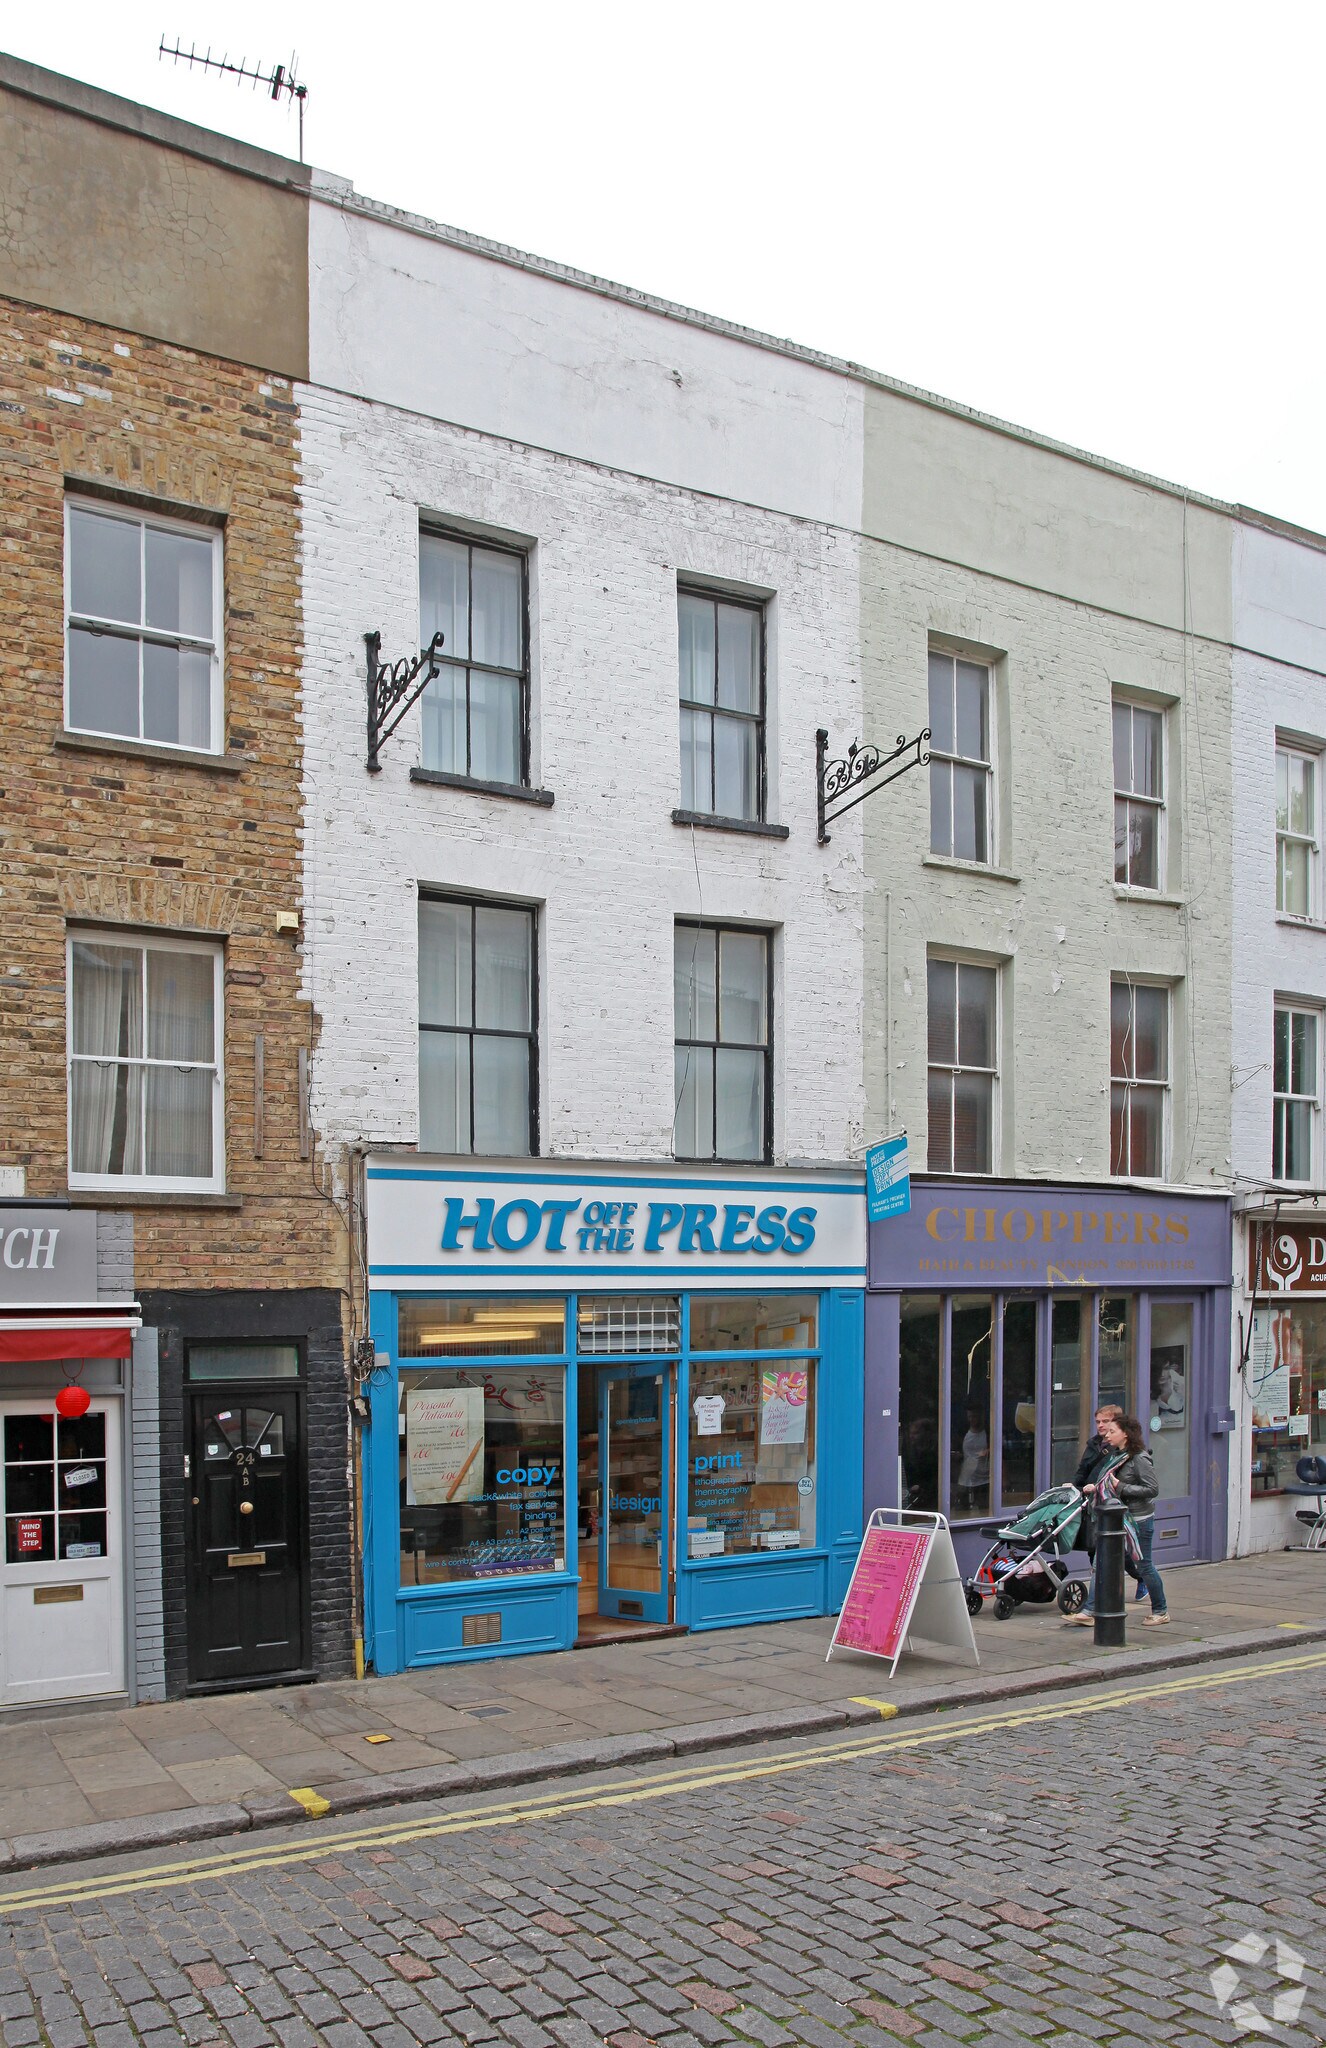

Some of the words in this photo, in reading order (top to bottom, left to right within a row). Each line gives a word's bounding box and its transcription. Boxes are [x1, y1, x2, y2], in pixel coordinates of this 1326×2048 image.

[872, 1158, 894, 1176] DESIGN
[874, 1169, 891, 1186] COPY
[876, 1176, 894, 1194] PRINT
[583, 1201, 638, 1225] OFF
[441, 1197, 583, 1250] HOT
[644, 1202, 818, 1253] PRESS
[925, 1206, 1190, 1244] CHOPPERS
[576, 1227, 635, 1251] THE
[919, 1258, 961, 1271] HAIR
[979, 1258, 1039, 1271] BEAUTY
[1046, 1258, 1110, 1271] LONDON
[412, 1397, 456, 1412] Personal
[615, 1416, 639, 1426] opening
[236, 1452, 255, 1466] 24
[694, 1450, 743, 1474] print
[72, 1473, 90, 1482] CLOSED
[242, 1467, 249, 1476] A
[496, 1466, 557, 1487] copy
[243, 1477, 250, 1486] B
[695, 1476, 737, 1486] lithography
[467, 1491, 523, 1502] black&white
[528, 1489, 557, 1499] colour
[694, 1486, 750, 1497] thermography
[509, 1502, 524, 1511] fax
[525, 1499, 557, 1510] service
[610, 1493, 662, 1515] design
[694, 1499, 717, 1508] digital
[718, 1497, 736, 1505] print
[524, 1511, 557, 1521] binding
[530, 1526, 556, 1535] posters
[469, 1540, 479, 1548] A4
[496, 1537, 522, 1546] printing
[911, 1534, 921, 1558] PERSONAL
[913, 1544, 922, 1565] STUDENT
[424, 1561, 440, 1569] wire
[447, 1558, 469, 1567] comb
[903, 1558, 914, 1585] STATIONERY
[905, 1565, 916, 1589] DISCOUNT
[898, 1585, 906, 1601] OFFER
[896, 1612, 906, 1634] POSTERS
